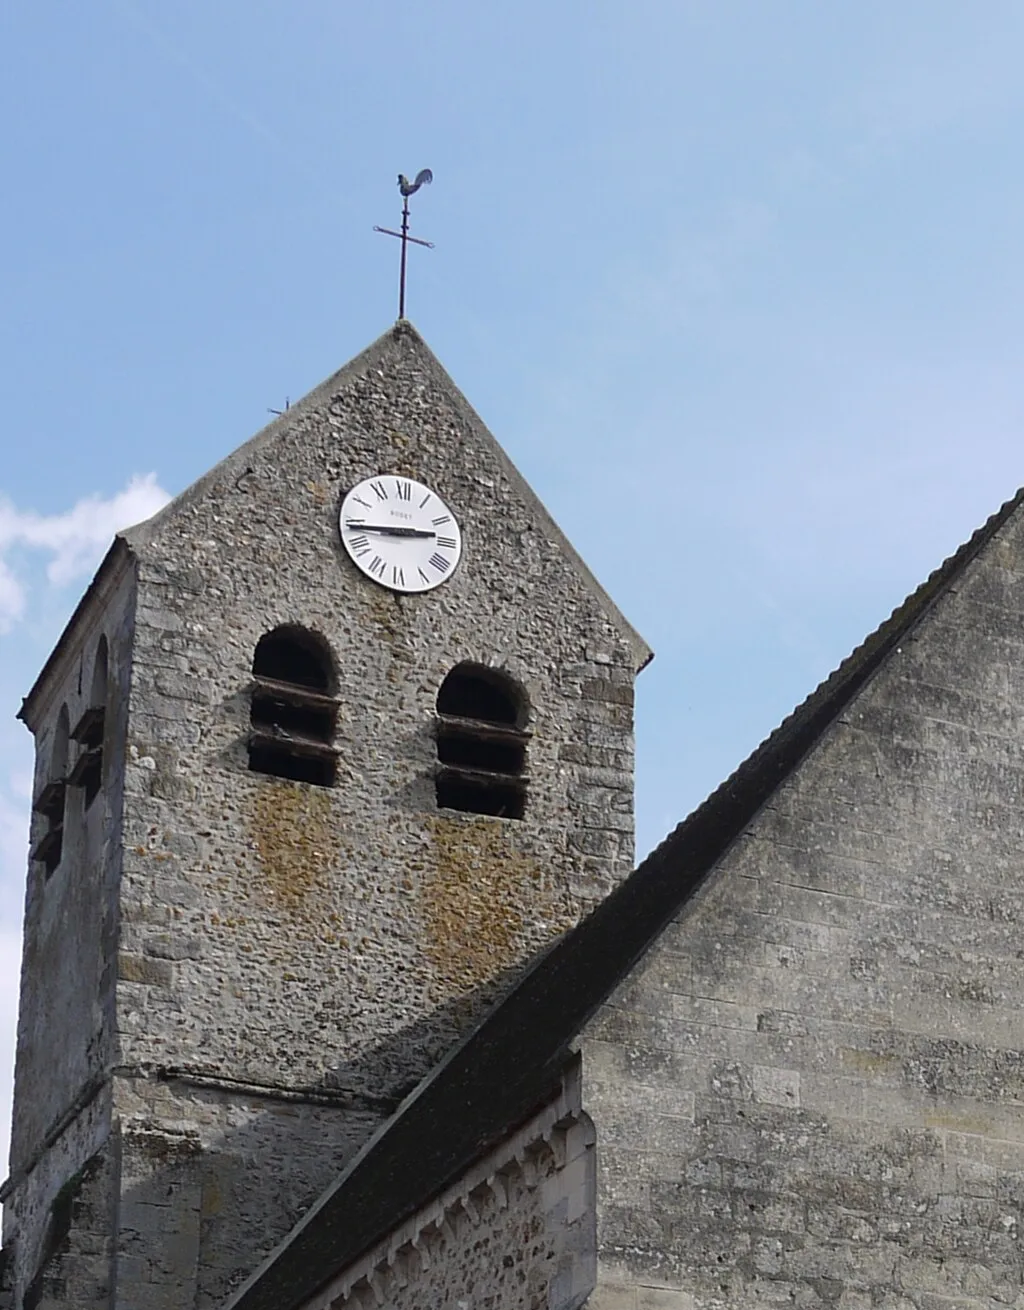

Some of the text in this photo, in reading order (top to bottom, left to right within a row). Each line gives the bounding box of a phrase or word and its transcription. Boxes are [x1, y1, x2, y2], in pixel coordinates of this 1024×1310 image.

[369, 481, 388, 502] XI
[395, 480, 411, 501] XII
[431, 515, 451, 526] II
[349, 535, 371, 557] VIII
[436, 536, 456, 549] III
[368, 555, 387, 579] VII
[428, 552, 451, 573] IIII
